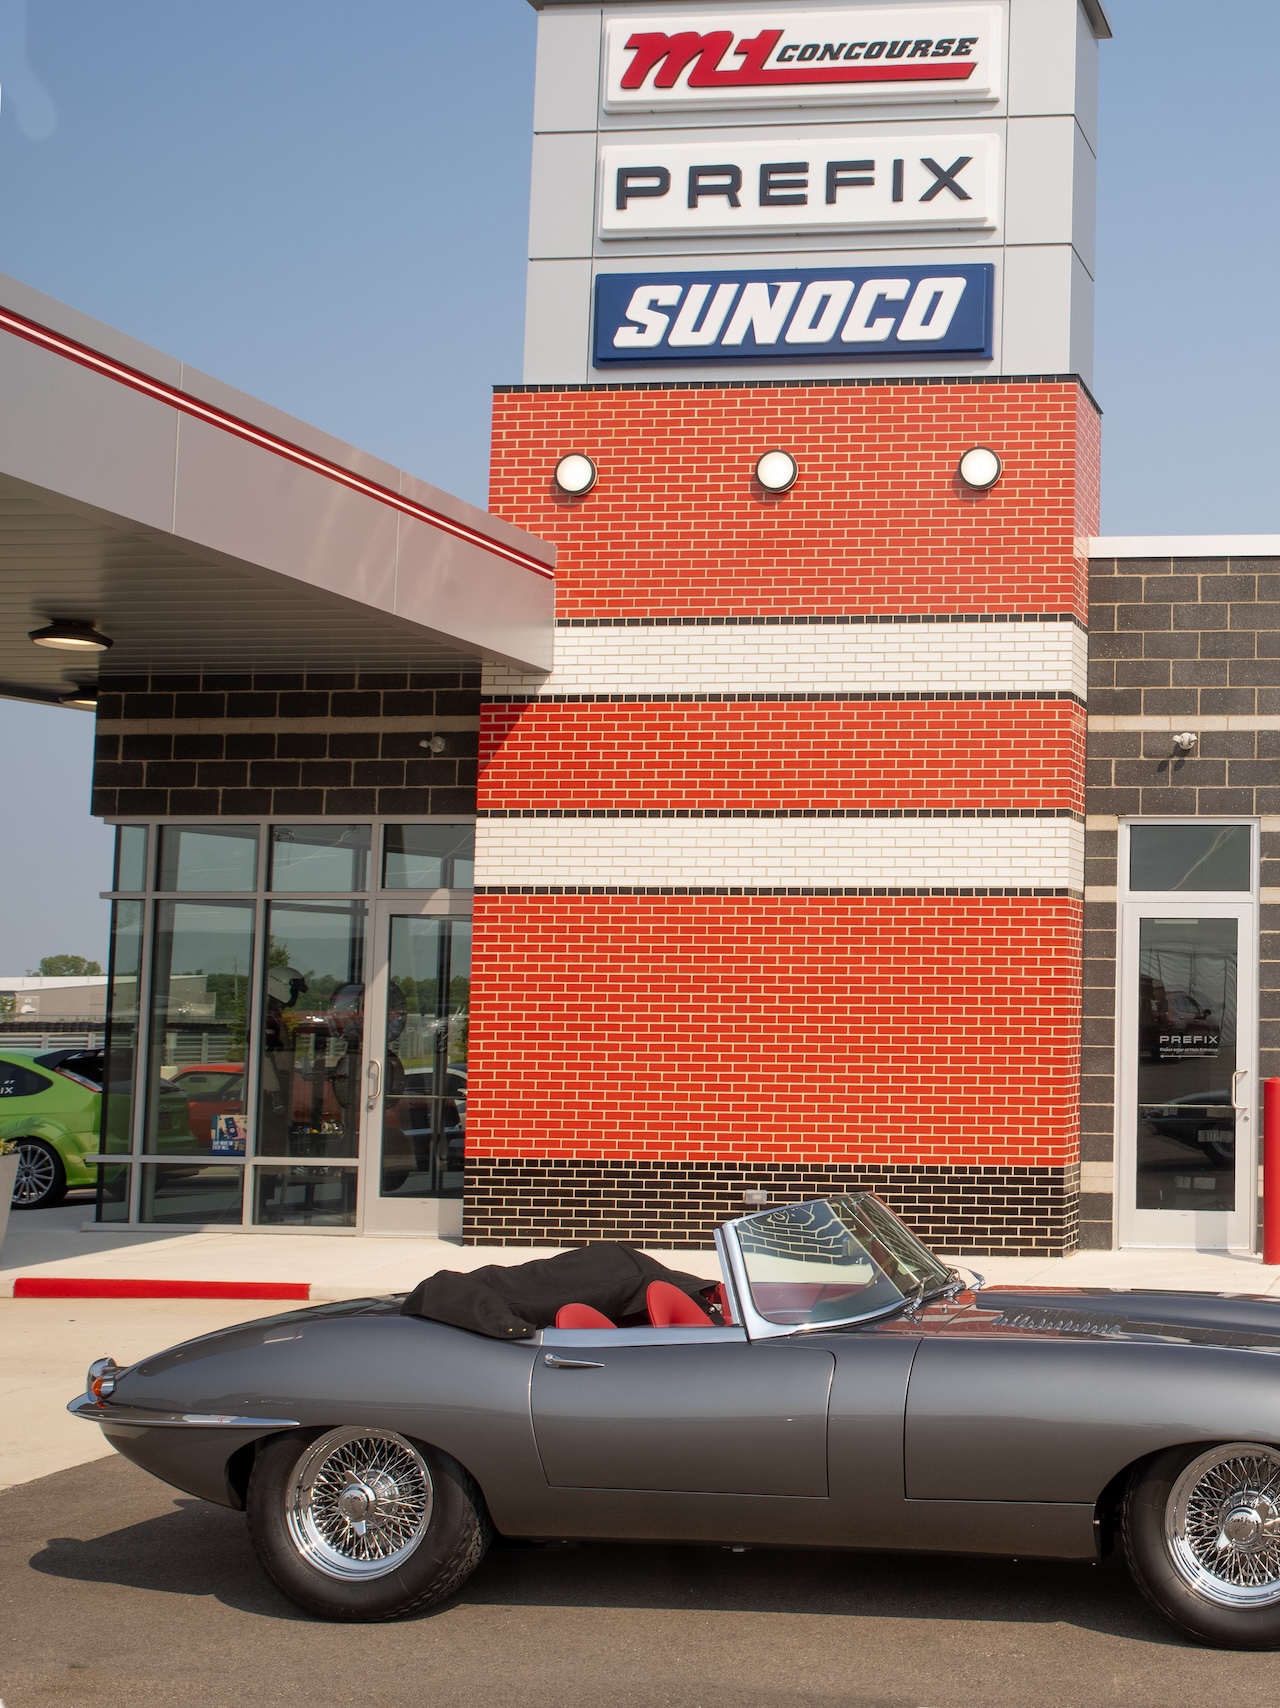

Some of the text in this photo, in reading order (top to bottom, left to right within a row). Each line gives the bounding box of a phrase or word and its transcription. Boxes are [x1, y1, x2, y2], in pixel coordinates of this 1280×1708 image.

[776, 37, 979, 62] CONCOURSE
[616, 156, 973, 210] PREFIX
[613, 277, 967, 348] SUNOCO
[1160, 1035, 1218, 1044] PREFIX
